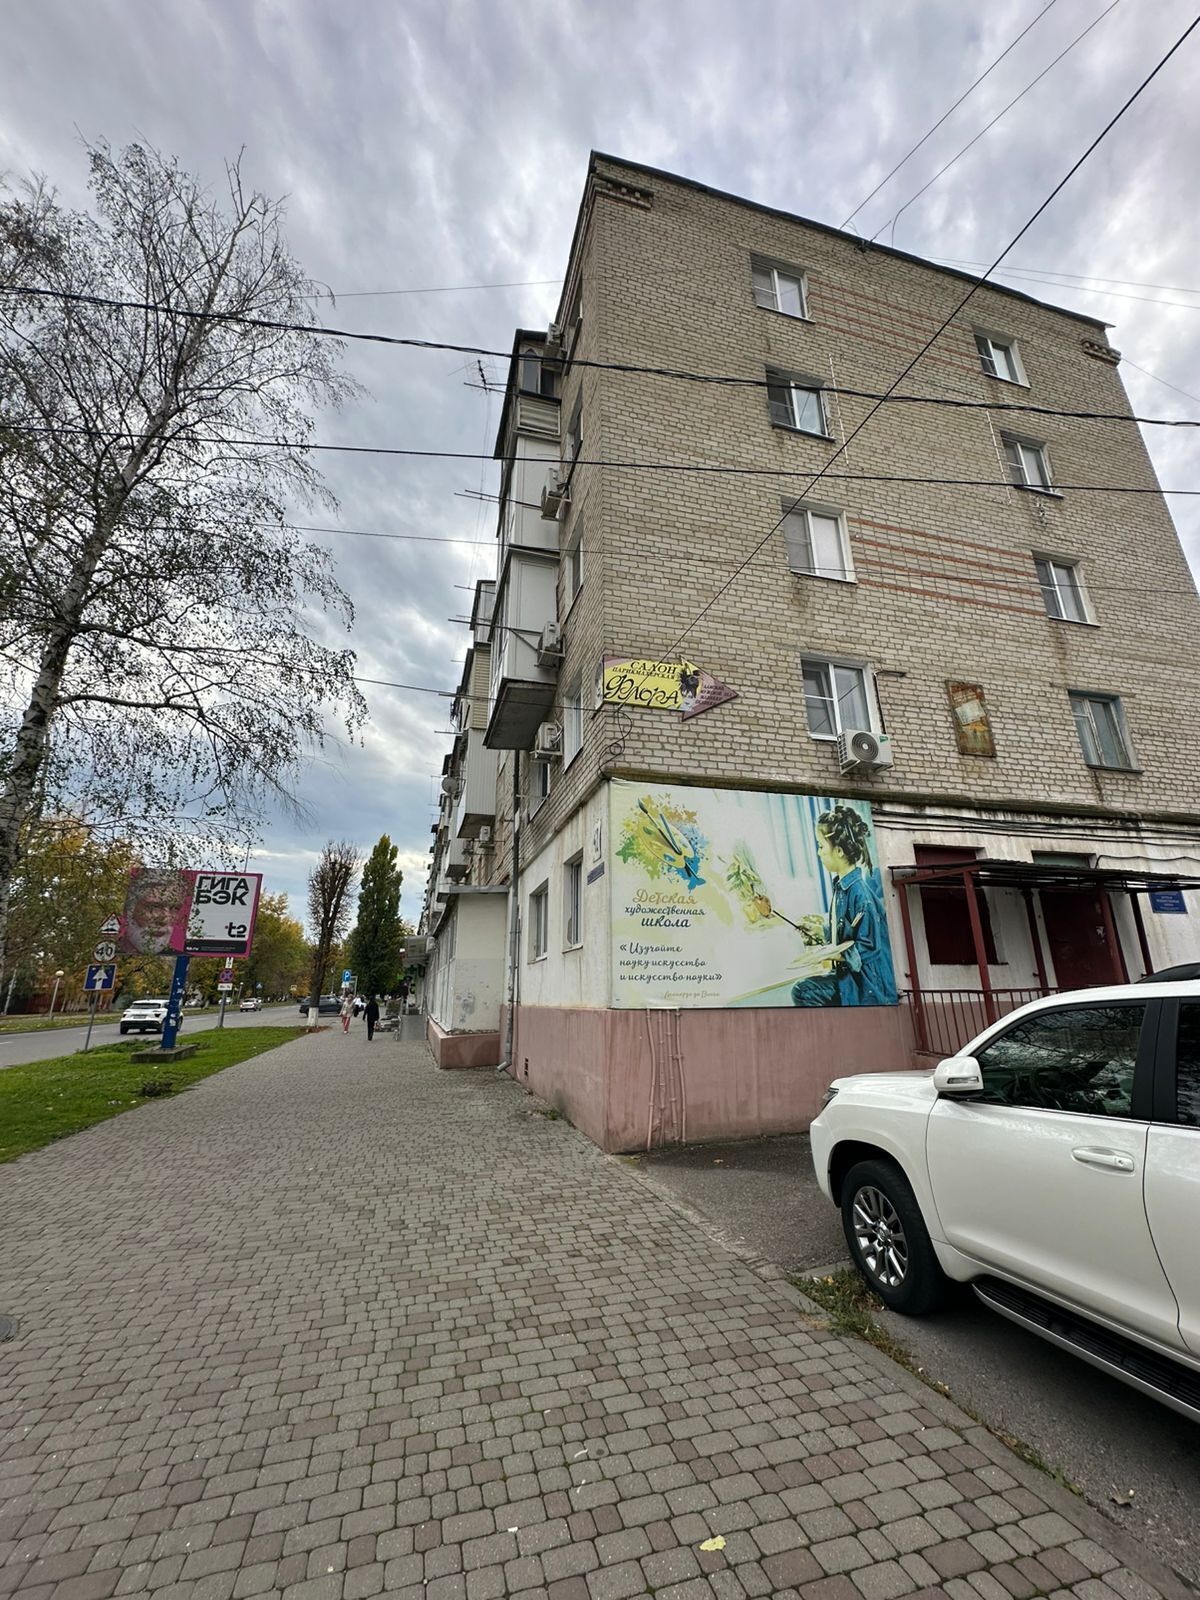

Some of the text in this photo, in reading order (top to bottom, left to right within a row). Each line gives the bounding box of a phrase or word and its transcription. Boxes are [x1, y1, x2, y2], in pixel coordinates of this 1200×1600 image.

[630, 661, 677, 675] САЛОН
[197, 876, 249, 891] ГИГА
[195, 889, 249, 906] БЭК
[632, 889, 698, 905] Детская
[625, 903, 706, 917] художественная
[641, 915, 692, 928] школа
[96, 946, 114, 957] 40
[619, 957, 706, 969] науку искусство
[628, 971, 684, 984] искусство
